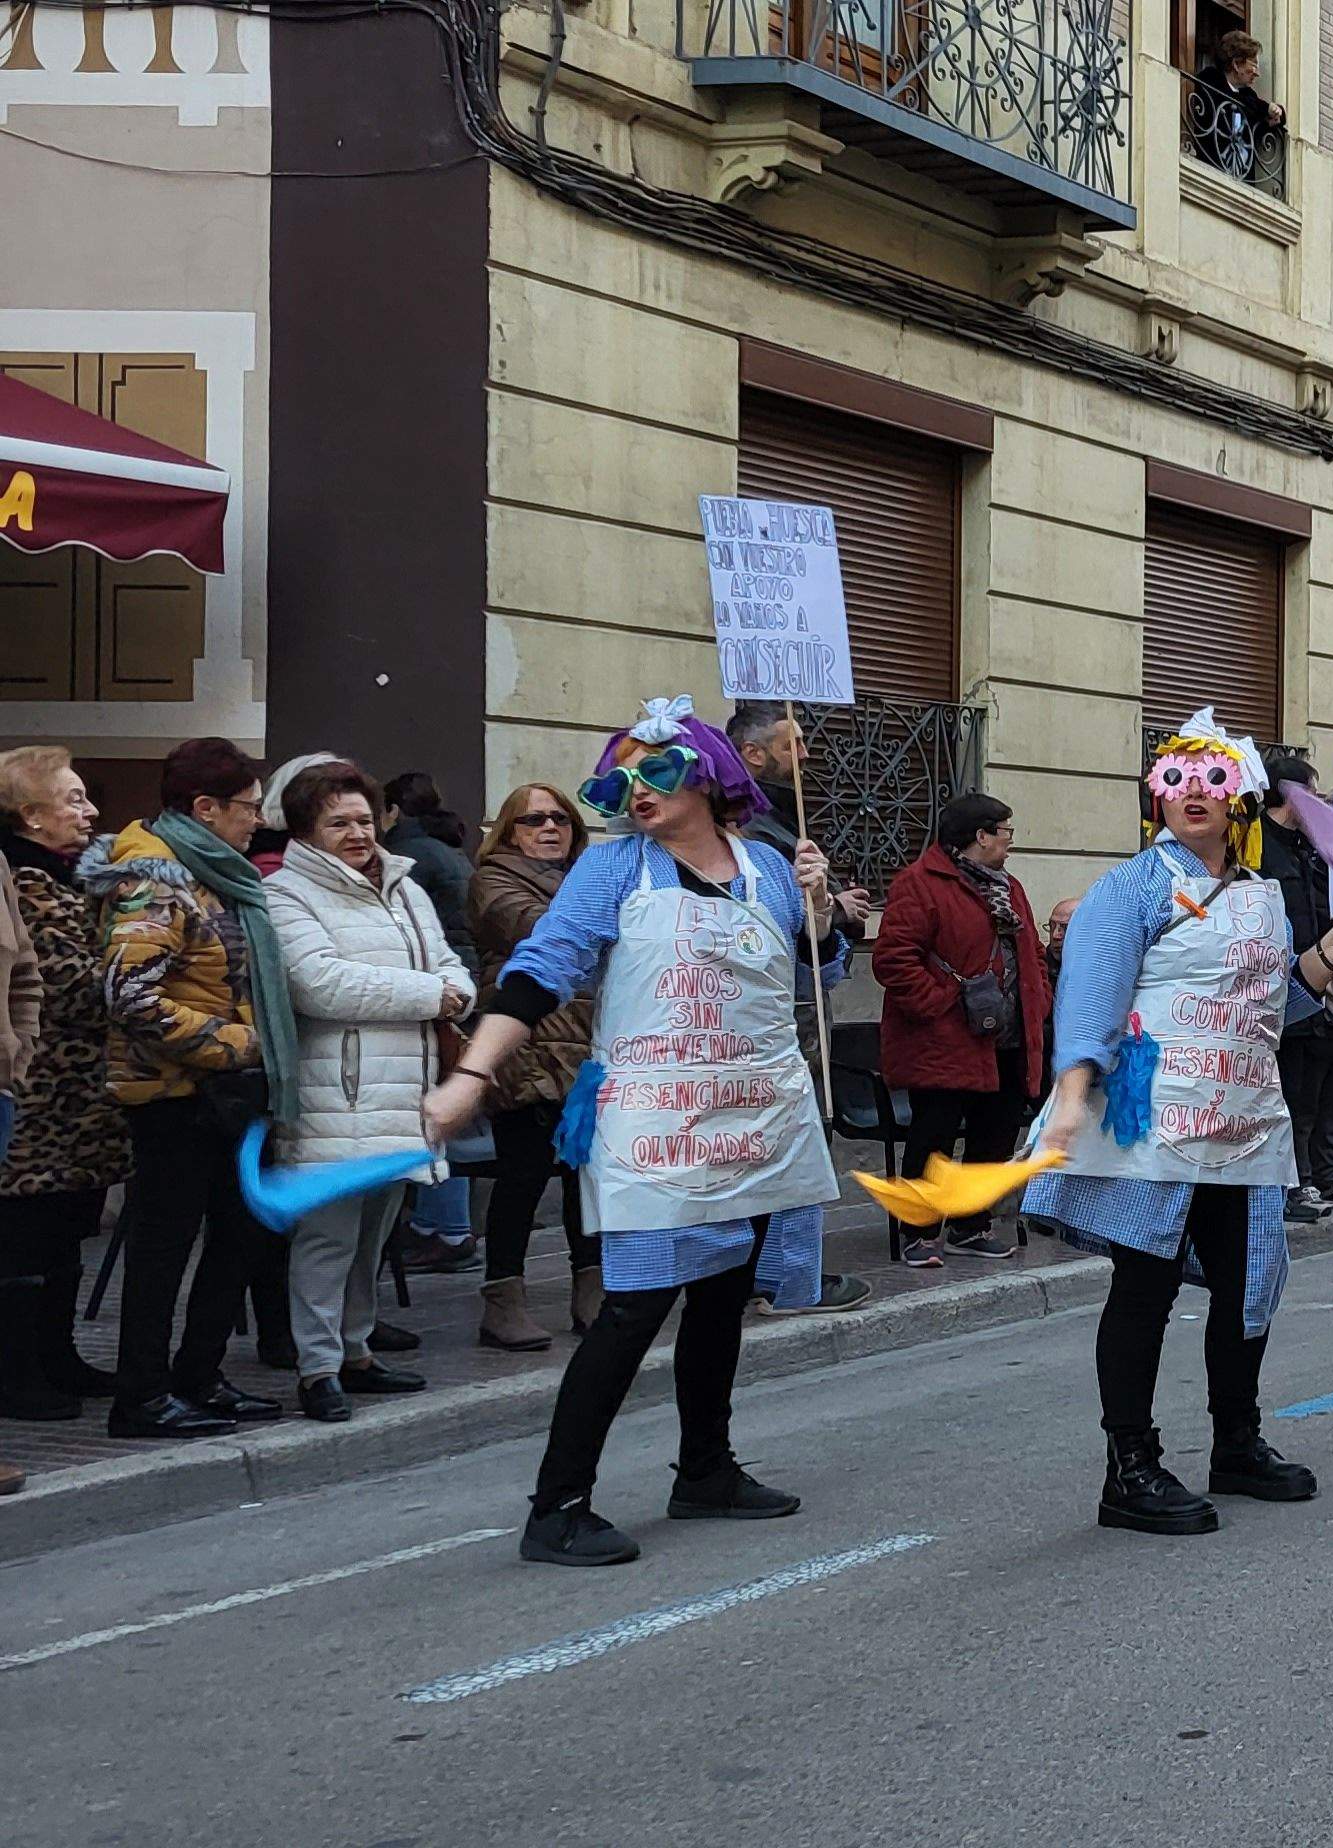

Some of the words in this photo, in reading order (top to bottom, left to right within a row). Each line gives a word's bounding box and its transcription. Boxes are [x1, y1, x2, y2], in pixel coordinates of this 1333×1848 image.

[731, 572, 794, 600] APOYO
[796, 606, 809, 632] A
[721, 634, 844, 698] CONSEGUIR
[1225, 881, 1275, 940] 5
[675, 895, 729, 966] 5
[1225, 939, 1288, 980] AÑOS
[654, 963, 743, 1000] AÑOS
[668, 1001, 723, 1031] SIN
[609, 1029, 755, 1066] CONVENIO
[632, 1130, 766, 1168] OLVIDADAS
